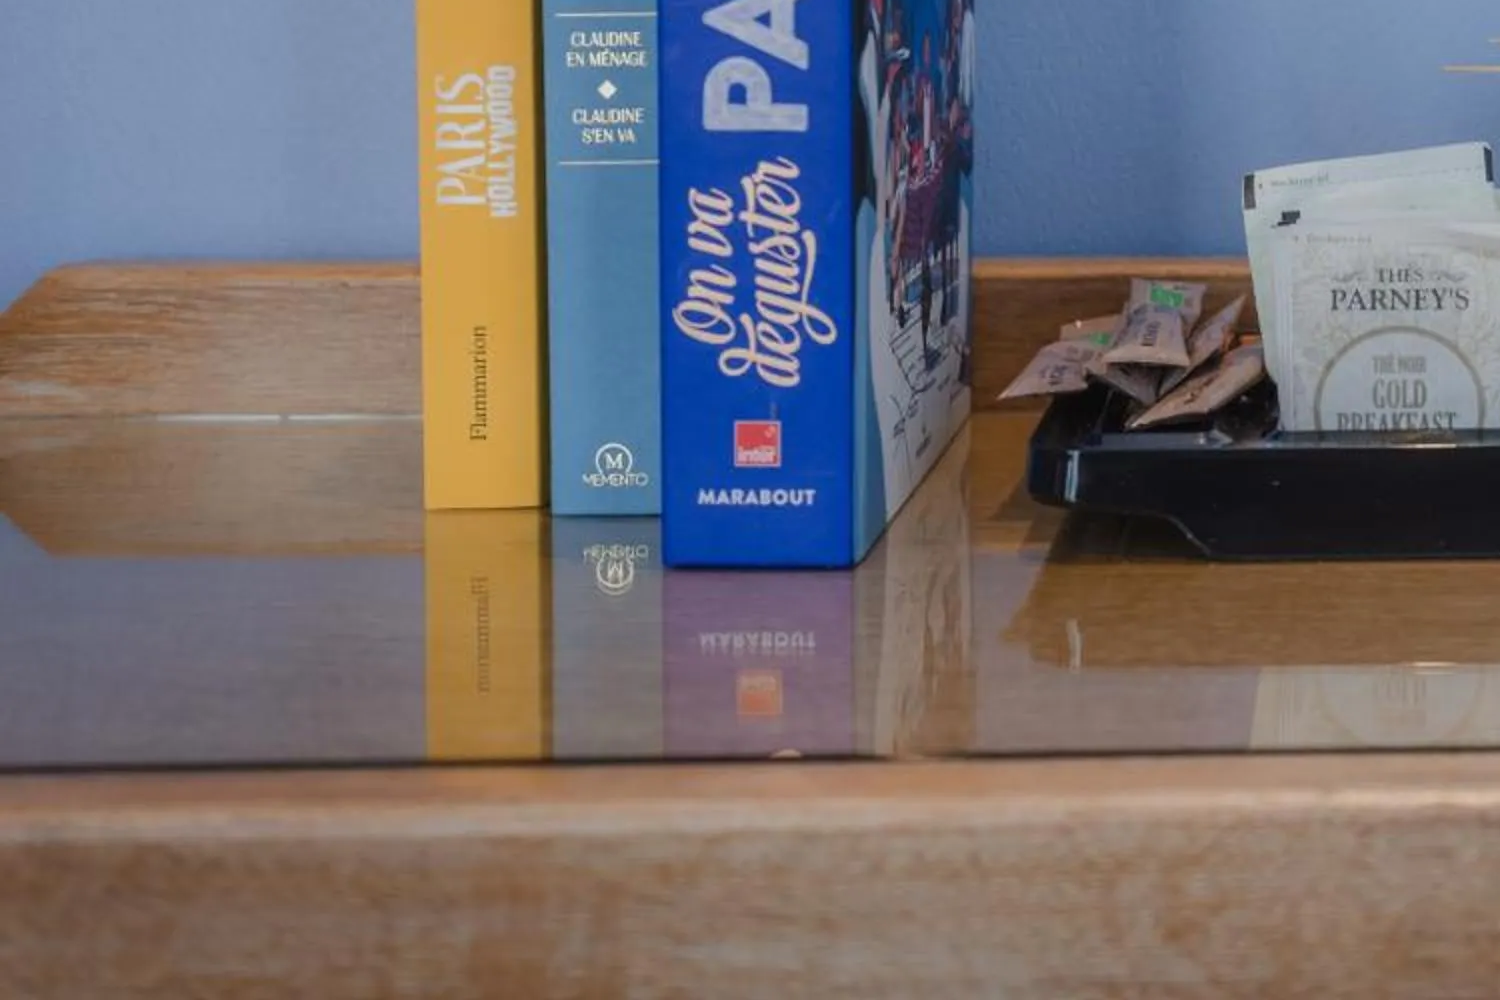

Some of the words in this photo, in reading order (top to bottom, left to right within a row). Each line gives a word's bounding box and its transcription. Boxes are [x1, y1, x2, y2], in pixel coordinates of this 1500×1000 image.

[570, 31, 643, 47] CLAUDINE
[566, 52, 585, 67] EN
[589, 49, 648, 67] MÉNAGE
[572, 107, 645, 124] CLAUDINE
[434, 72, 486, 205] PARIS
[487, 64, 517, 218] HOLLYWOOD
[581, 127, 614, 144] S'EN
[617, 128, 636, 143] VA
[687, 187, 735, 258] va
[1375, 264, 1425, 283] THÉS
[672, 264, 737, 345] On
[1330, 289, 1470, 311] PARNEY'S
[470, 325, 487, 441] Flammarion
[1373, 378, 1428, 409] GOLD
[604, 452, 623, 469] M
[697, 488, 816, 506] MARABOUT
